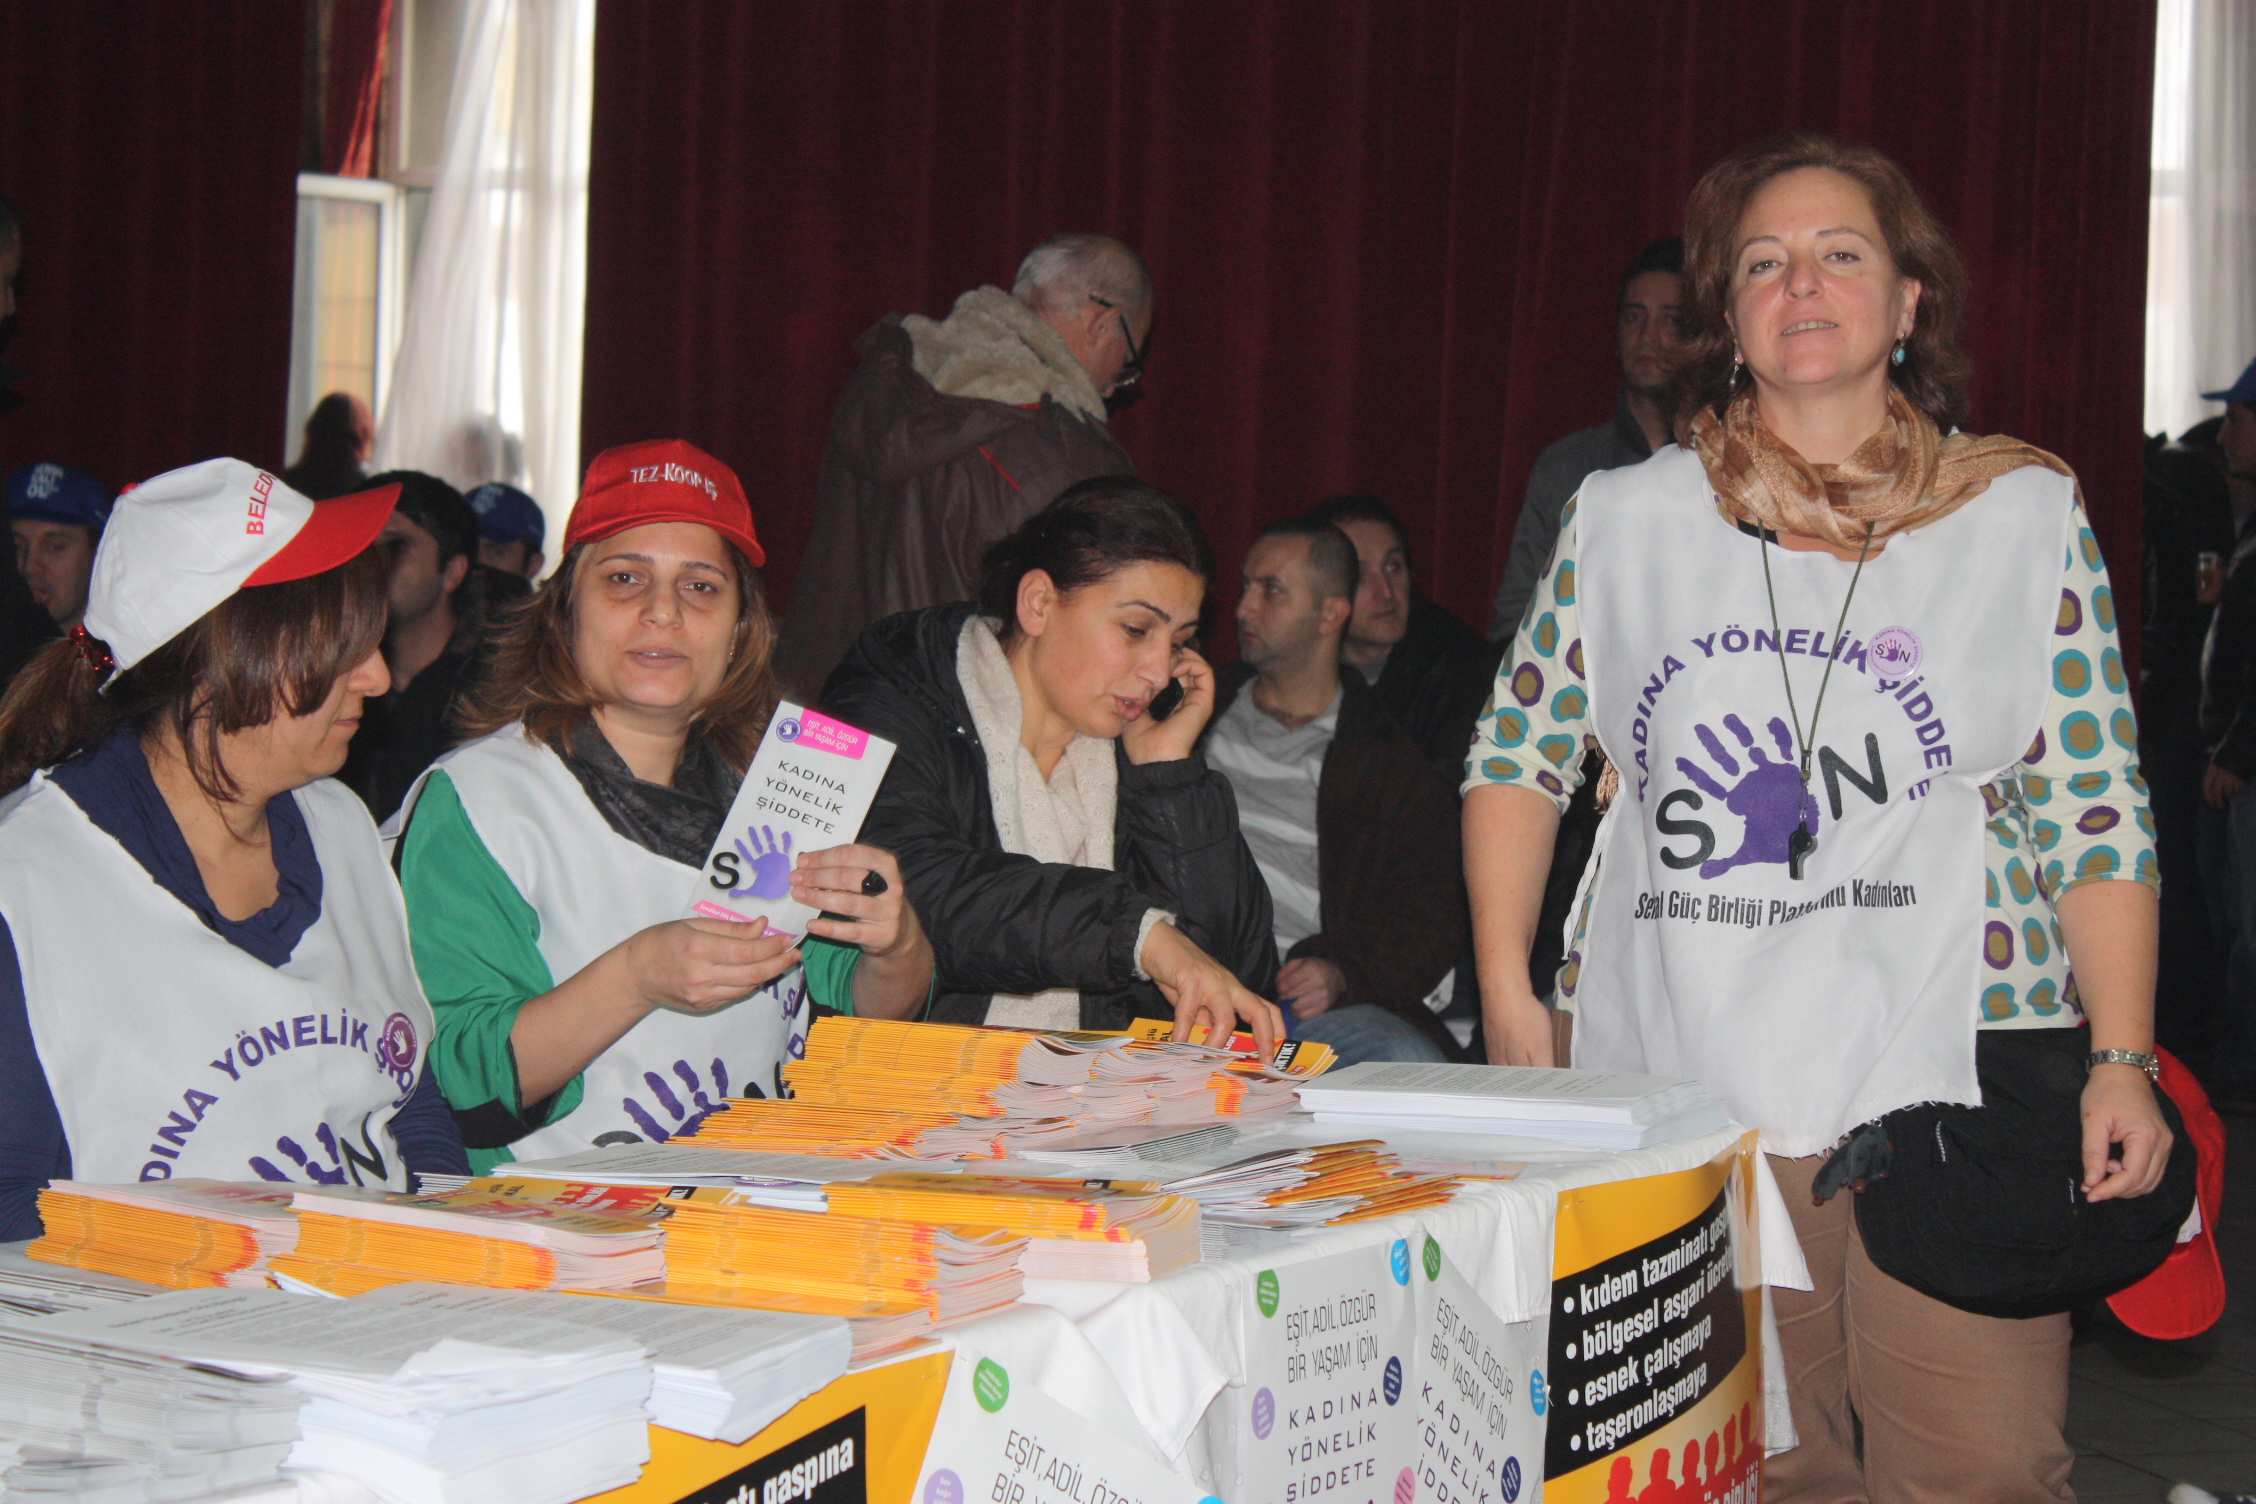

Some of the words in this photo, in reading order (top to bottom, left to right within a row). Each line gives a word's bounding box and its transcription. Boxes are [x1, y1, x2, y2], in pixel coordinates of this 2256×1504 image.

[1632, 654, 1687, 803] KADINA
[1691, 624, 1867, 675] YÖNELİK
[755, 796, 836, 834] ŞİDDETE
[765, 776, 844, 816] YÖNELİK
[778, 760, 846, 794] KADINA
[1668, 890, 1702, 925] Güç
[1706, 894, 1763, 929] Birliği
[1852, 879, 1917, 908] Kadınları
[138, 1088, 220, 1183] DINA
[209, 1008, 370, 1082] YÖNELİK
[1580, 1267, 1639, 1316] kıdem
[1641, 1226, 1709, 1289] tazminatı
[1582, 1297, 1660, 1362] bölgesel
[1663, 1269, 1706, 1324] asgari
[1287, 1348, 1307, 1384] BİR
[1311, 1341, 1352, 1380] YAŞAM
[1355, 1330, 1378, 1371] İÇİN
[1430, 1333, 1449, 1372] BİR
[1451, 1356, 1486, 1415] YAŞAM
[1486, 1394, 1508, 1441] İÇİN
[1584, 1355, 1640, 1407] esnek
[1643, 1314, 1713, 1386] çalışmaya
[1286, 1420, 1377, 1466] YÖNELİK
[1288, 1387, 1378, 1430] KADINA
[1421, 1380, 1496, 1481] KADINA
[1586, 1362, 1708, 1451] taşeronlaşmaya
